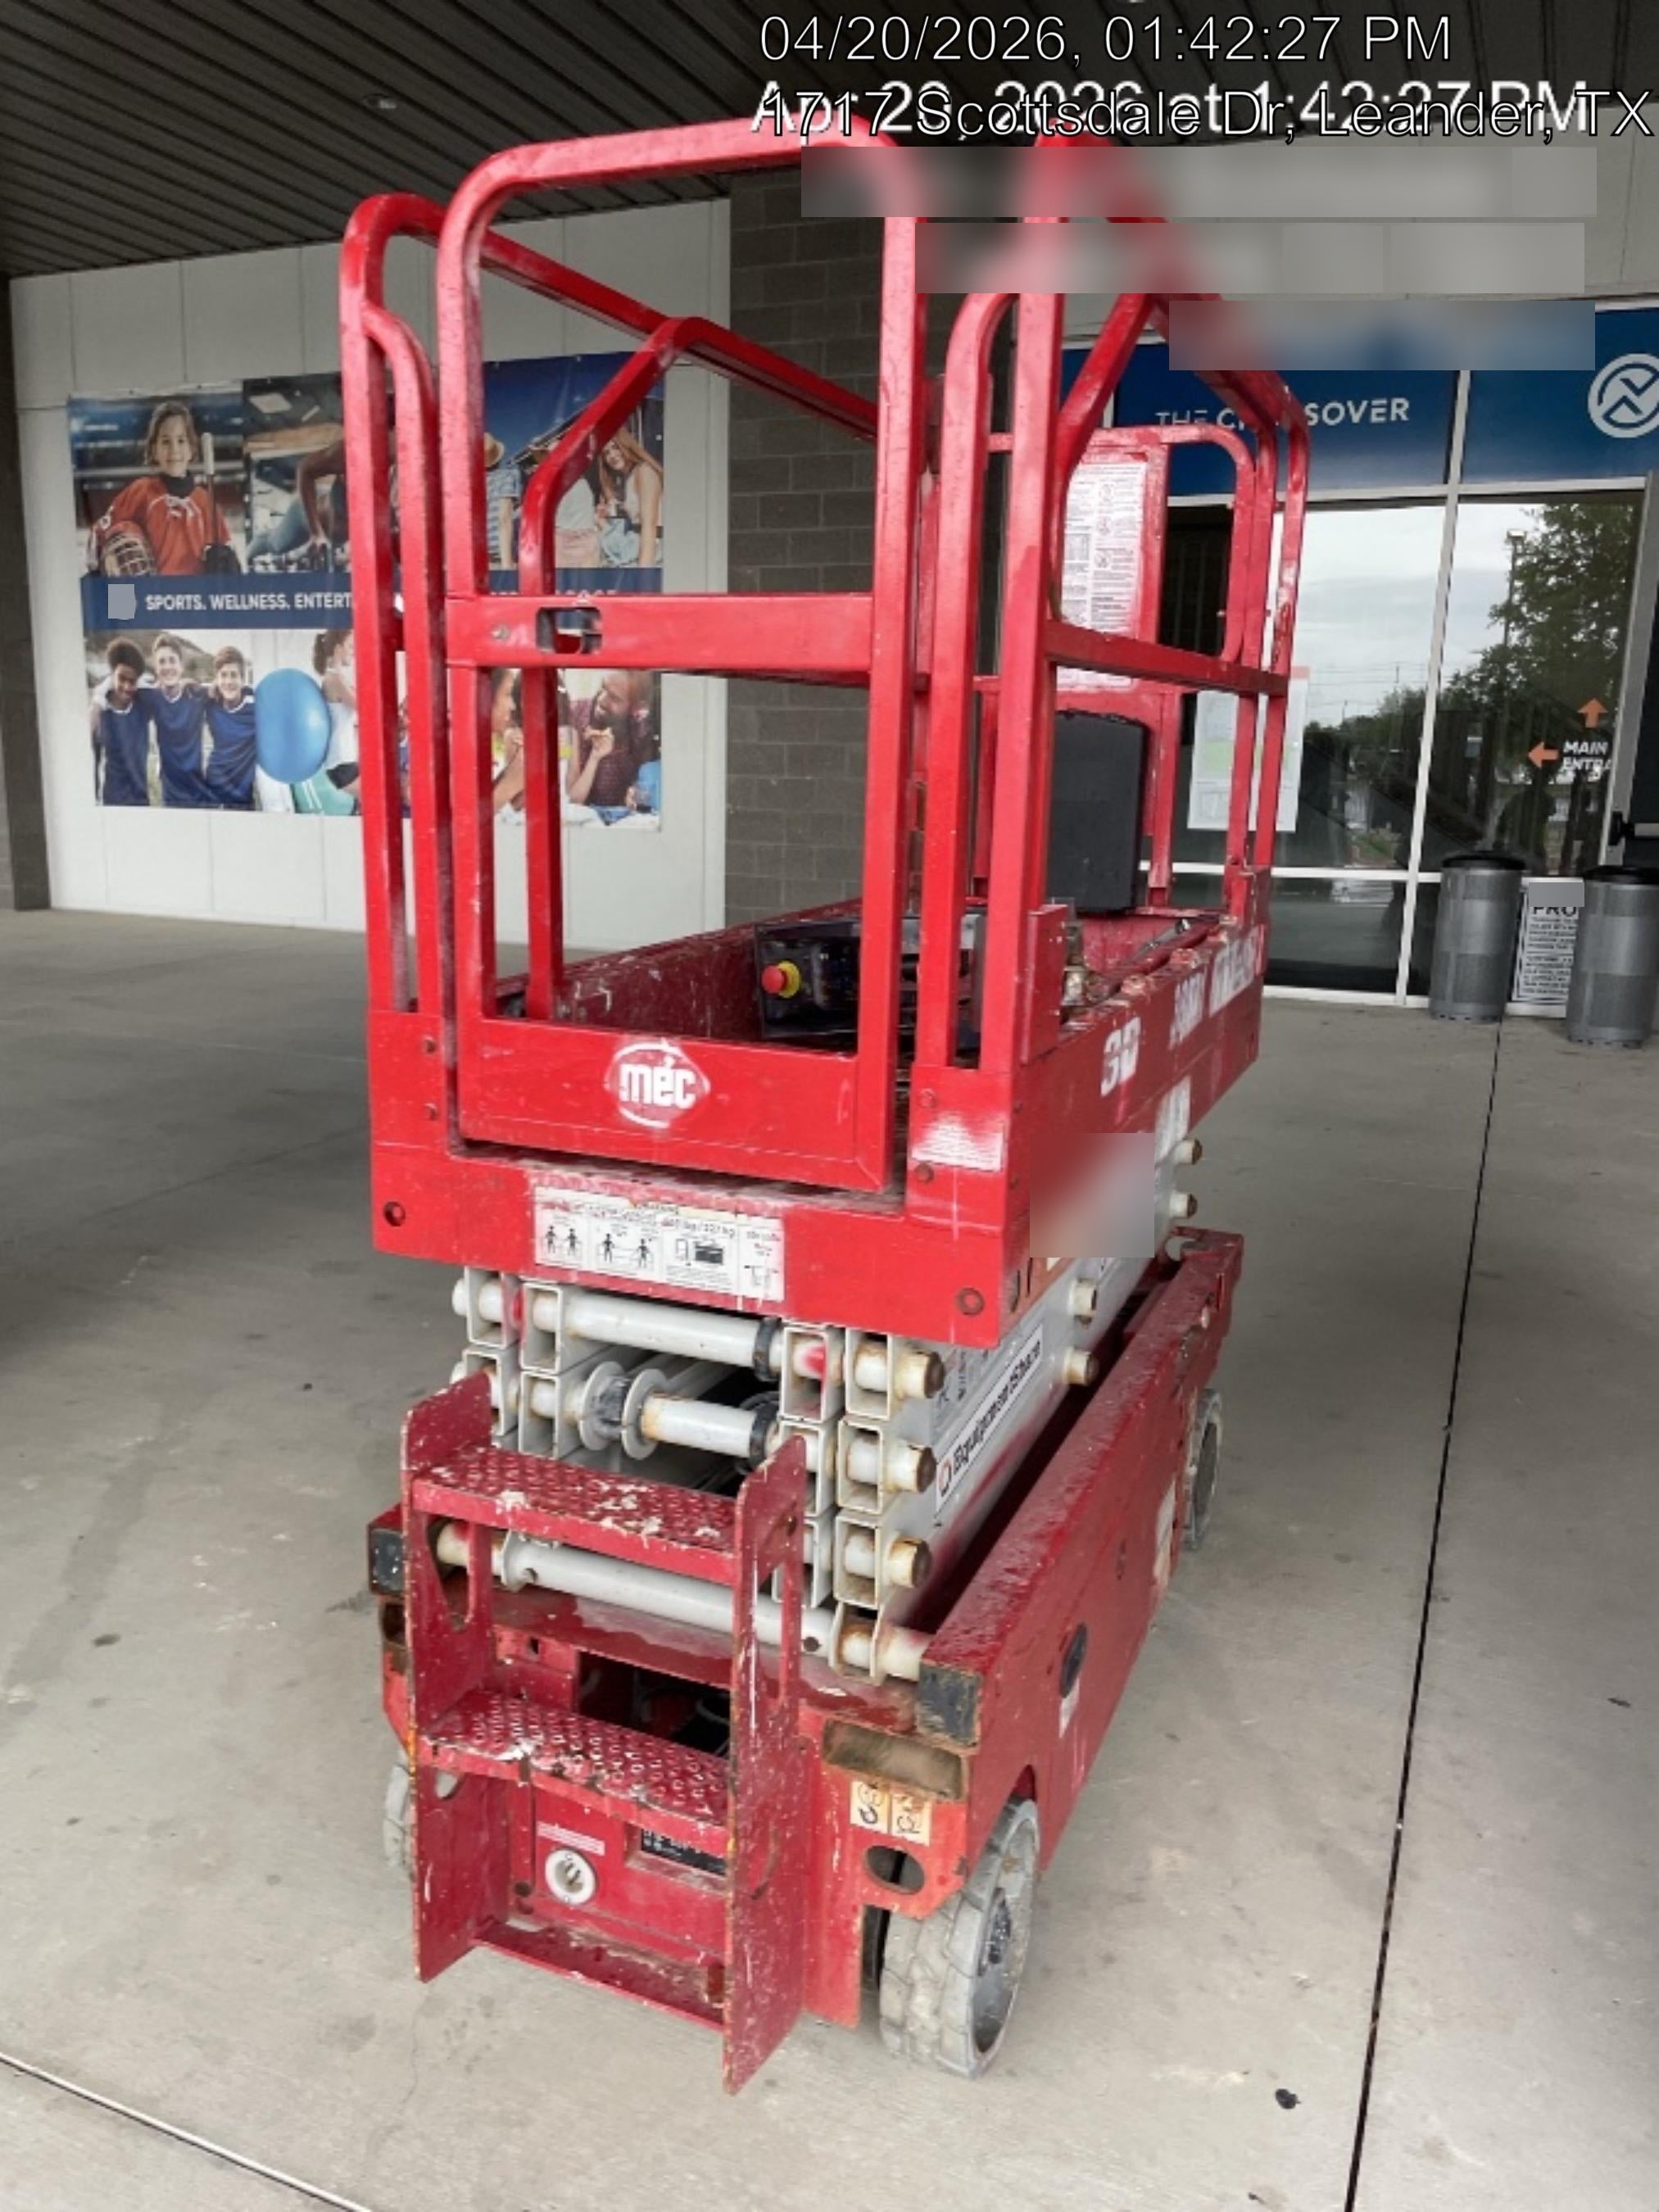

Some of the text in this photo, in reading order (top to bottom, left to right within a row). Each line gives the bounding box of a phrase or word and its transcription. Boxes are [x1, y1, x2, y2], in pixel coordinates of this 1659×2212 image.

[1216, 397, 1411, 430] CSOVER
[145, 594, 207, 611] SPORTS.
[210, 593, 290, 611] WELLNESS.
[1563, 741, 1609, 755] MAIN
